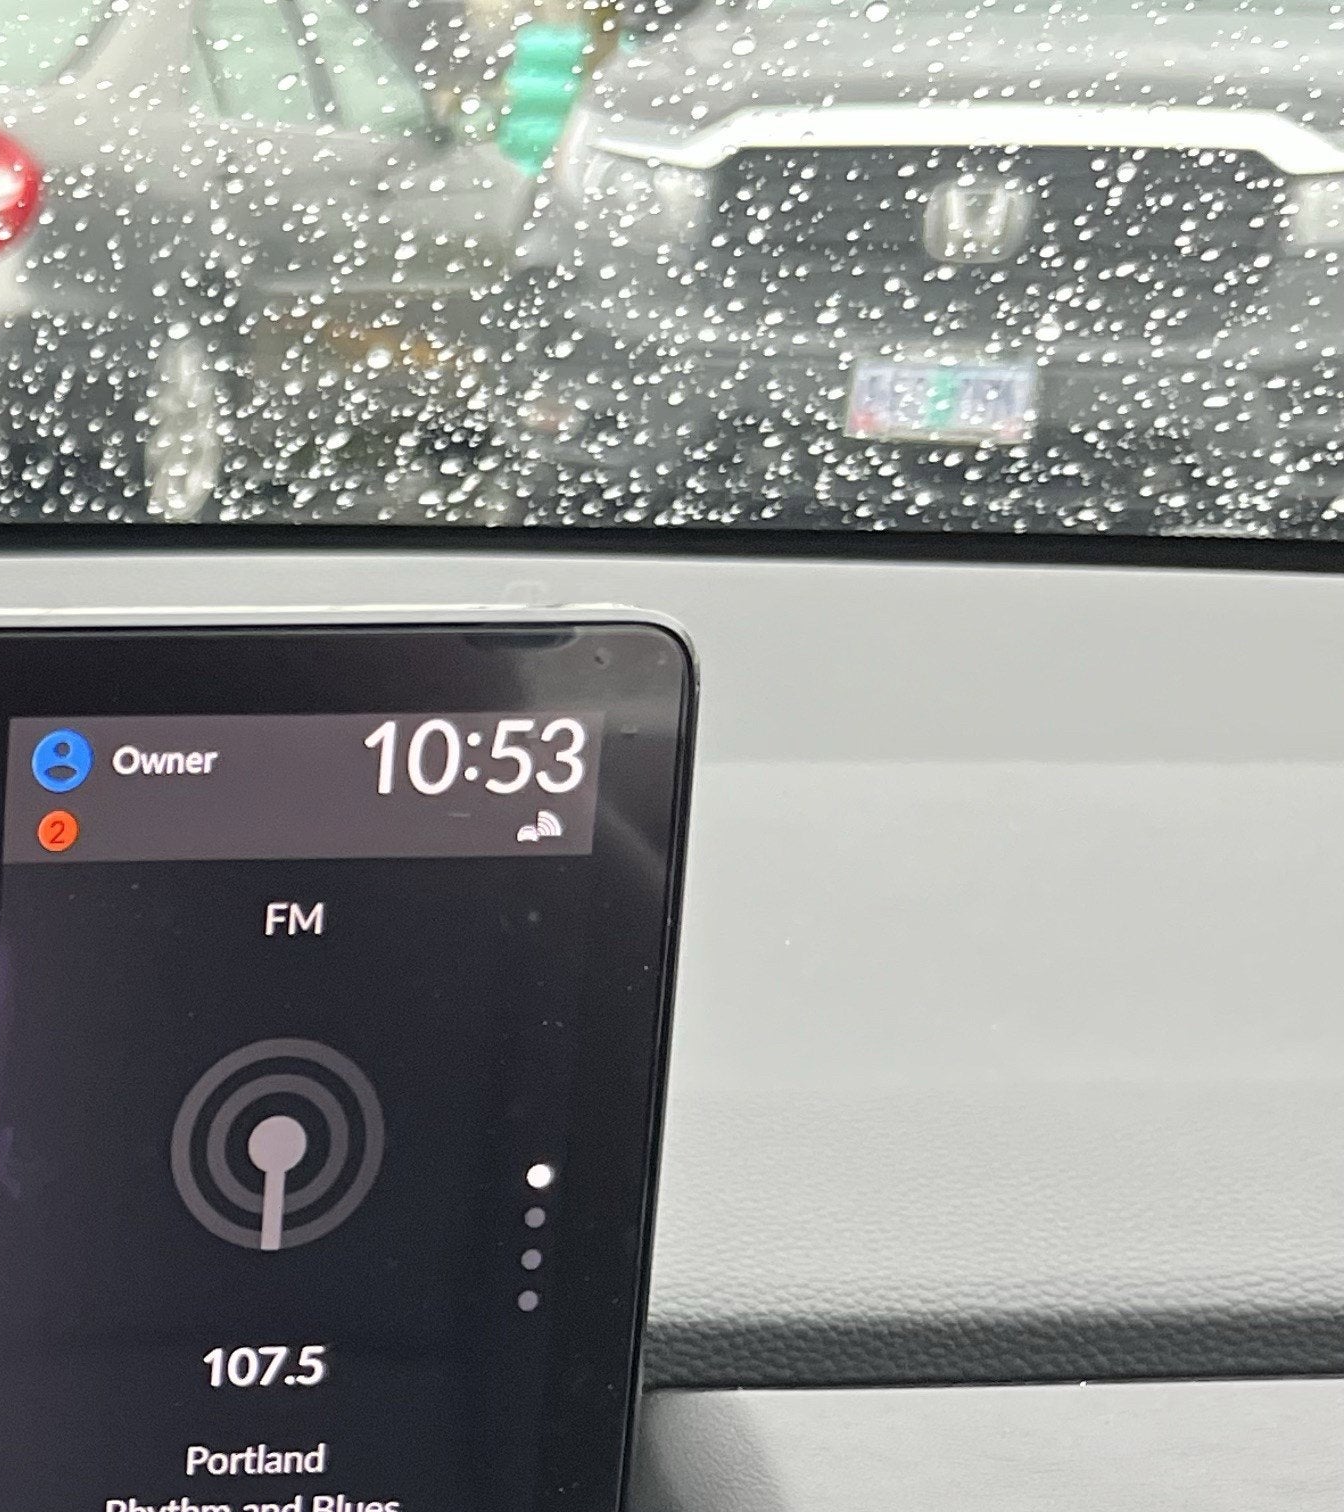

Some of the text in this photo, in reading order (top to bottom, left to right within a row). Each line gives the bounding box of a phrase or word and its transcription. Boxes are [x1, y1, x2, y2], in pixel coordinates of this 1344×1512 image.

[112, 745, 219, 775] Owner
[364, 717, 587, 795] 10:53
[49, 820, 66, 845] 2
[265, 902, 324, 936] FM
[203, 1345, 325, 1387] 107.5
[186, 1442, 326, 1476] Portland
